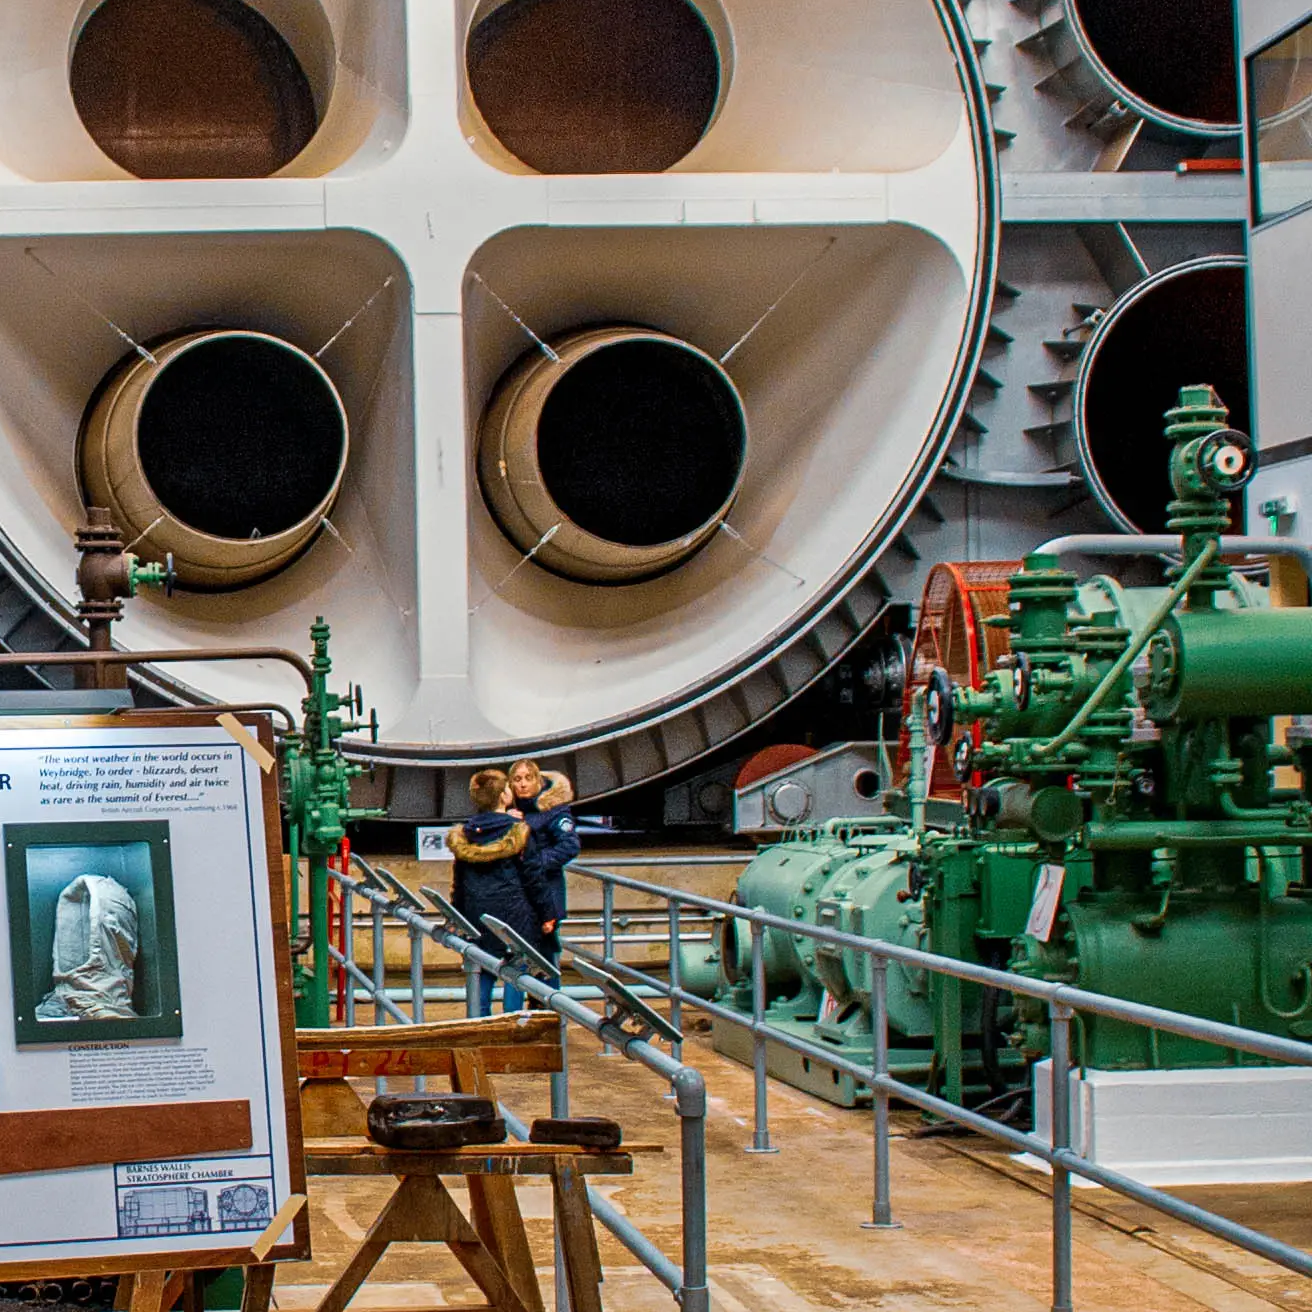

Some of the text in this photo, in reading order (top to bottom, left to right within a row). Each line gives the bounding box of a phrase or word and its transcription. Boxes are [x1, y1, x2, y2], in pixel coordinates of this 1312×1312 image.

[63, 756, 89, 764] worst
[92, 754, 130, 763] weather
[132, 752, 141, 762] in
[144, 752, 159, 762] the
[161, 752, 189, 761] world
[223, 751, 233, 760] in
[95, 767, 106, 776] To
[107, 766, 134, 776] order
[189, 765, 219, 774] desert
[65, 780, 99, 792] driving
[125, 779, 167, 790] humidity
[169, 778, 187, 788] and
[189, 777, 202, 787] air
[204, 777, 230, 787] twice
[53, 797, 73, 805] rare
[87, 794, 103, 803] the
[105, 793, 140, 803] summit
[142, 792, 153, 803] of
[126, 1163, 191, 1173] BARNES WALLIS
[126, 1170, 234, 1182] STRATOSPHERE CHAMBER
